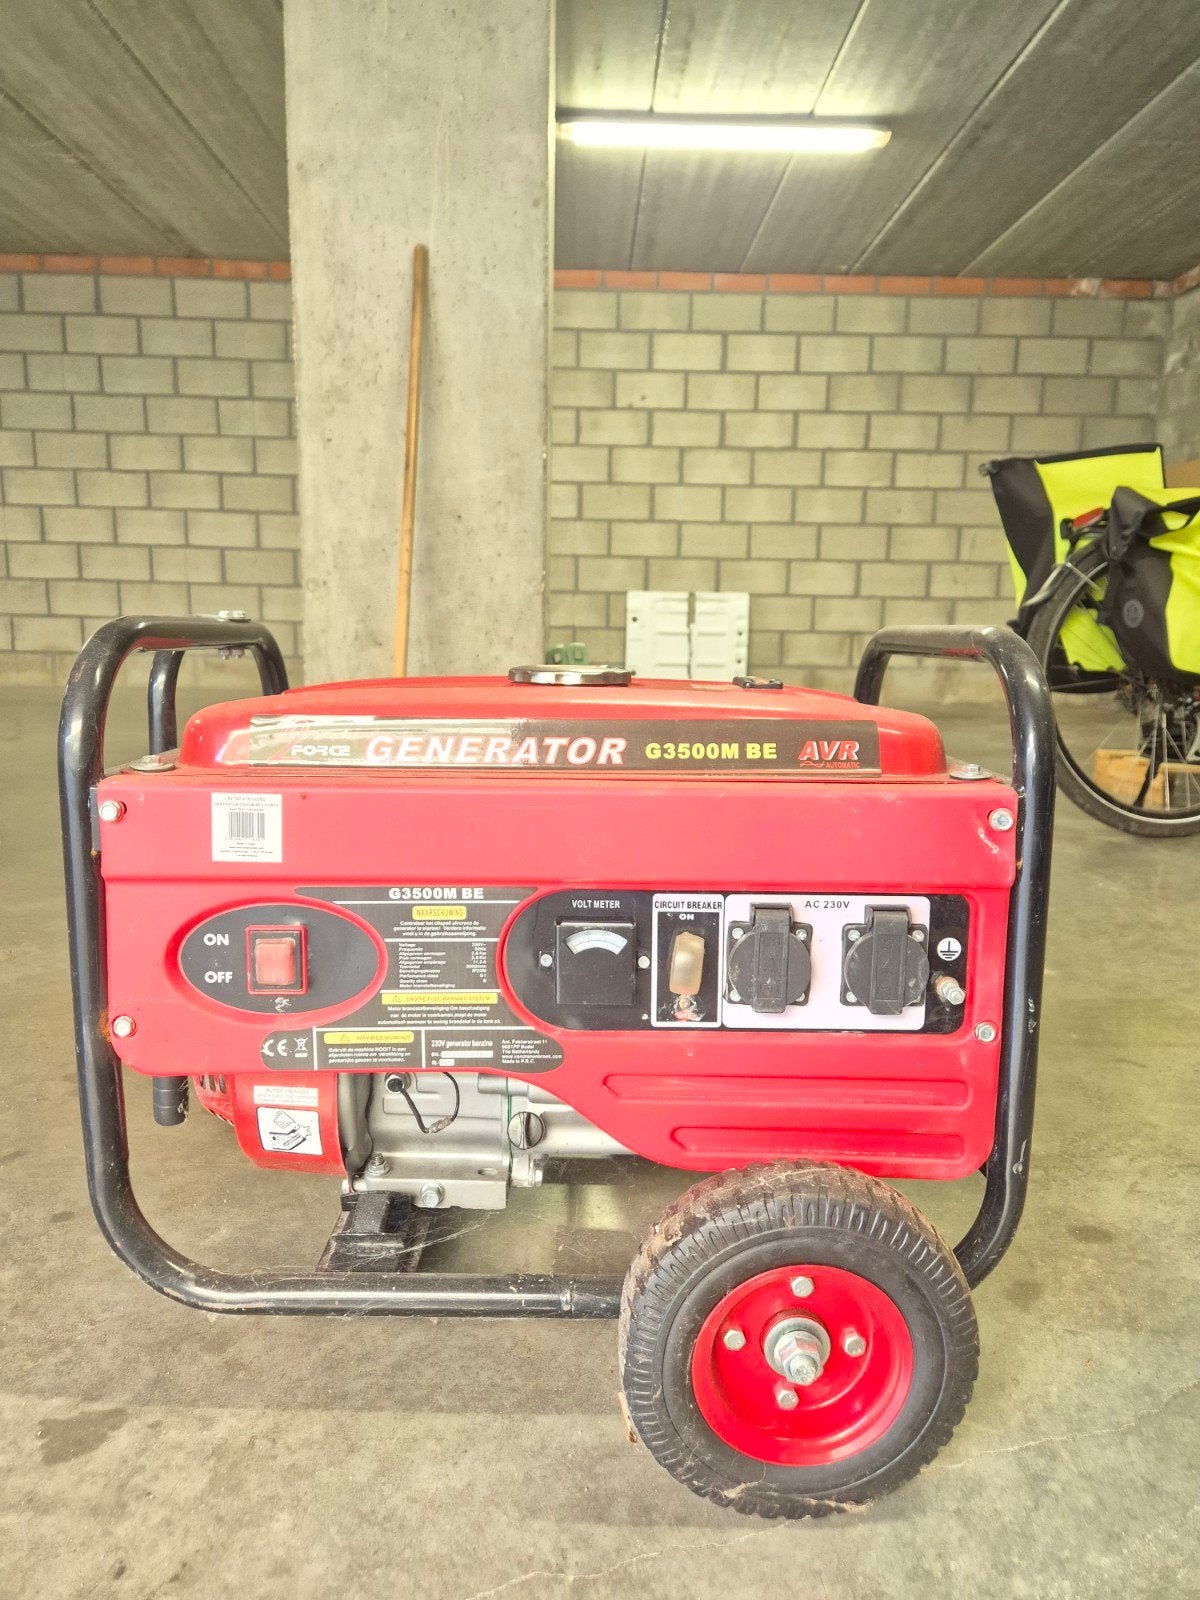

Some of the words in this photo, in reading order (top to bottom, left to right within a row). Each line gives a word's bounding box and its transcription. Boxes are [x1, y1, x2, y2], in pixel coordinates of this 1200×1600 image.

[291, 744, 350, 757] FORCE
[365, 735, 627, 766] GENERATOR
[645, 742, 739, 760] G3500M
[746, 742, 777, 760] BE
[798, 740, 860, 761] AVR
[824, 761, 860, 769] AUTOMATIC
[388, 887, 457, 900] G3500M
[461, 887, 484, 900] BE
[571, 899, 592, 909] VOLT
[593, 899, 621, 909] METER
[654, 900, 685, 909] CIRCUIT
[686, 901, 723, 910] BREAKER
[804, 900, 820, 909] AC
[824, 900, 850, 909] 230V
[678, 913, 695, 921] ON
[203, 933, 230, 946] ON
[204, 970, 233, 984] OFF
[431, 1039, 446, 1048] 230V
[445, 1039, 472, 1049] generator
[471, 1039, 493, 1047] benzine
